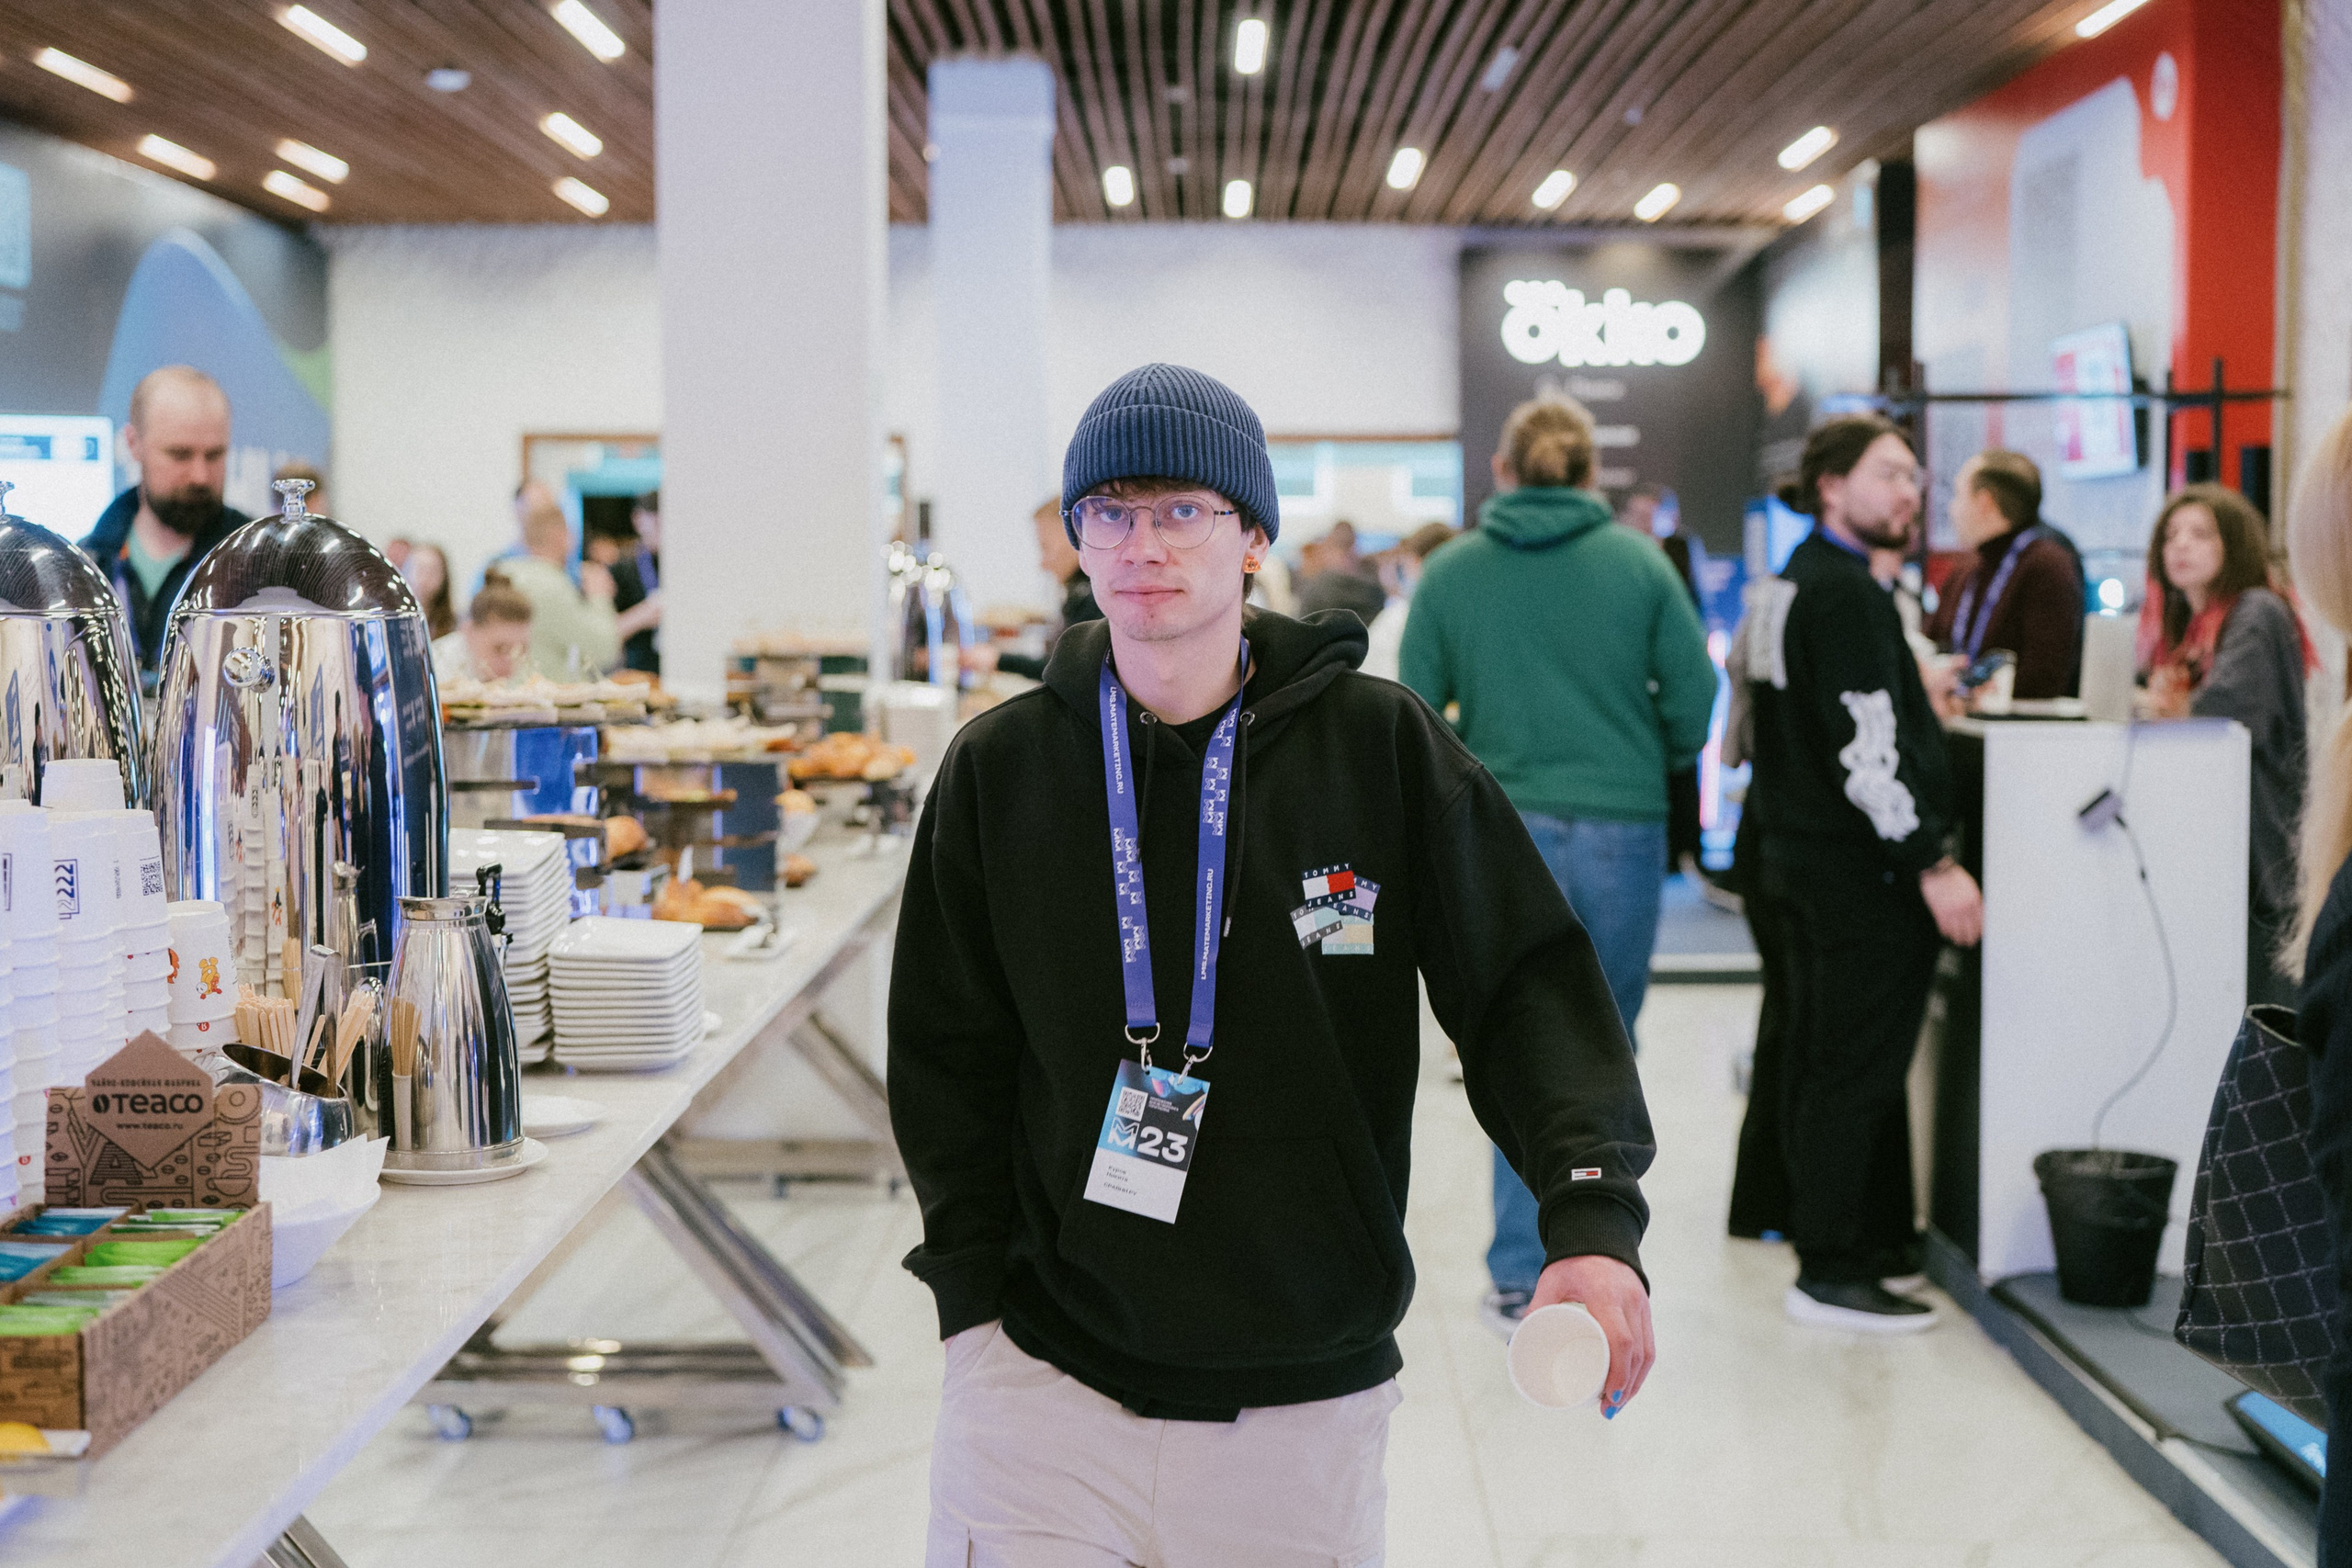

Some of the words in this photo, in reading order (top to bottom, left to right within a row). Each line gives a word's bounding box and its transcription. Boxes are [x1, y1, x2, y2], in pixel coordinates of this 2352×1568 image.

[1304, 863, 1350, 879] TOMMY
[1307, 891, 1354, 908] JEANS
[1301, 923, 1341, 947] JEANS
[116, 1122, 184, 1130] www.teaco.ru
